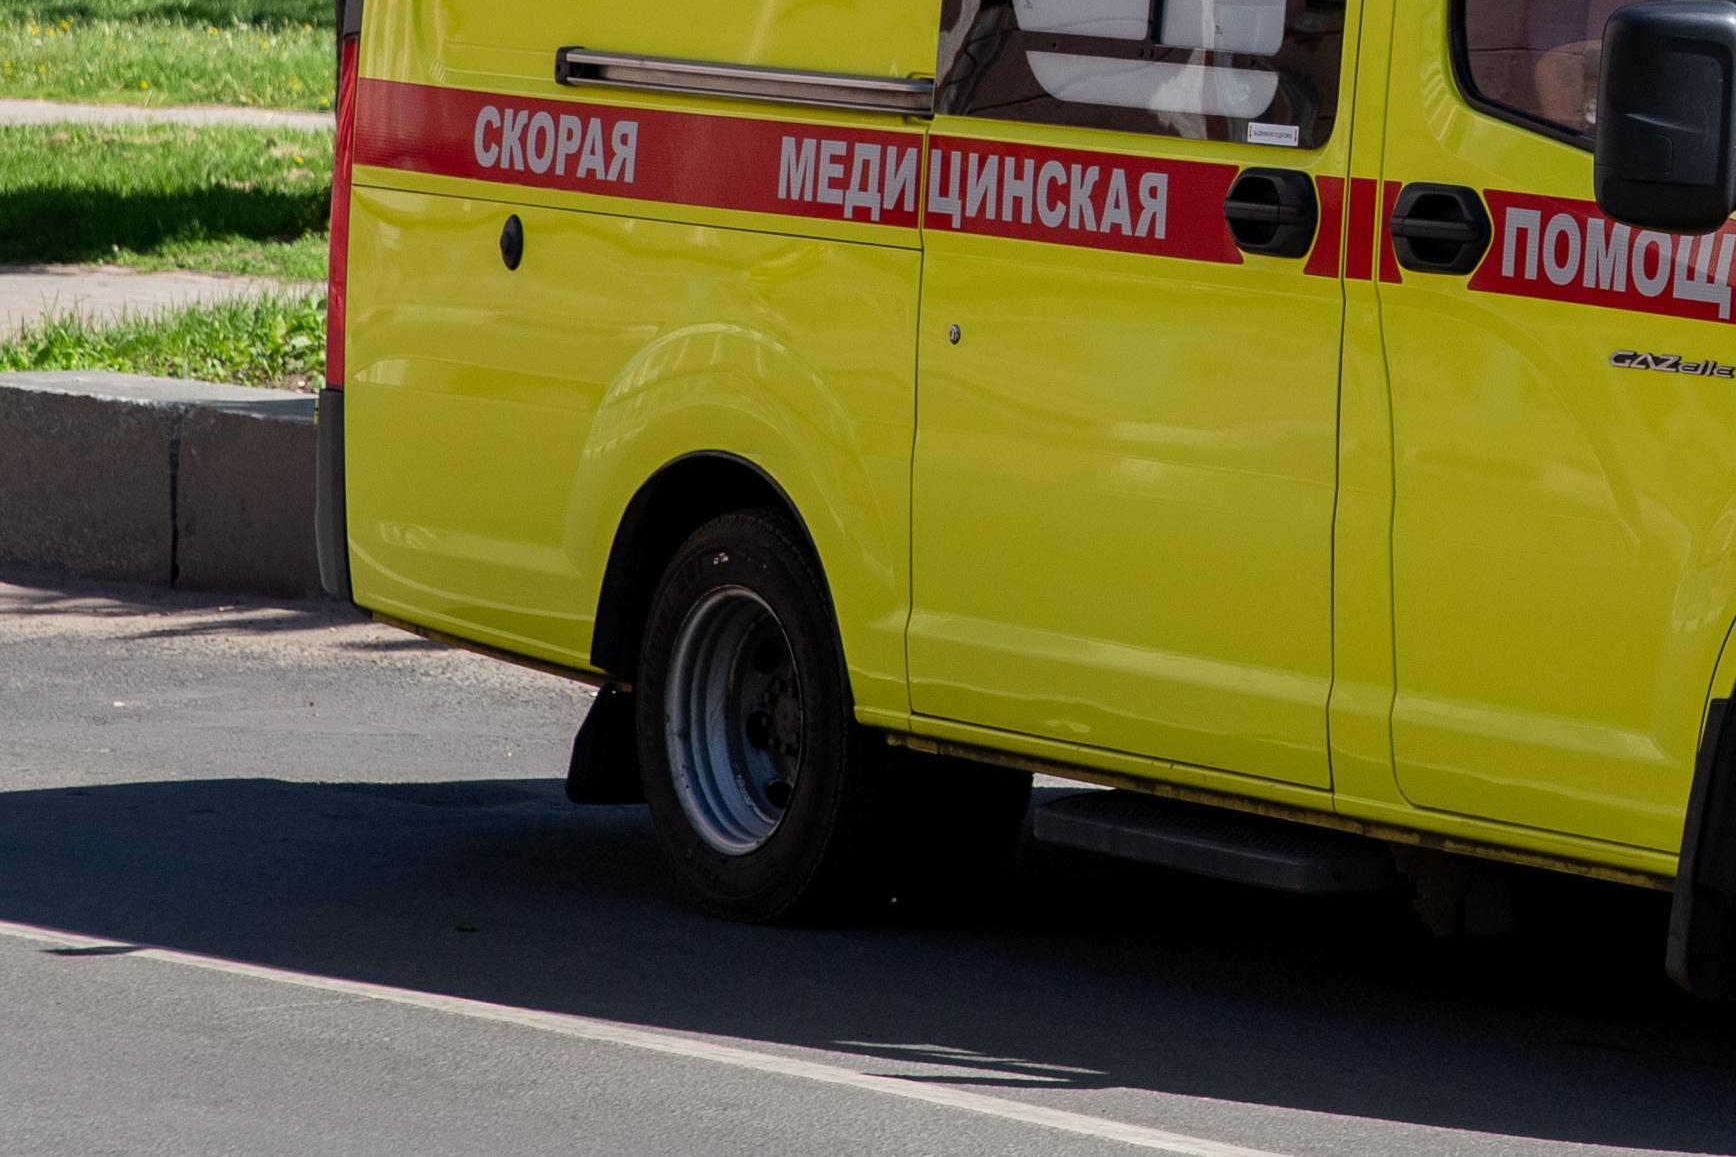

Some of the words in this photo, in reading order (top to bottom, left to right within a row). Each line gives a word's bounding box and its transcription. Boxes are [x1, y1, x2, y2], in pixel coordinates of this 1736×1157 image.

[474, 105, 639, 183] СКОРАЯ
[777, 135, 1170, 240] МЕДИЦИНСКАЯ
[1608, 349, 1736, 379] GAZelle
